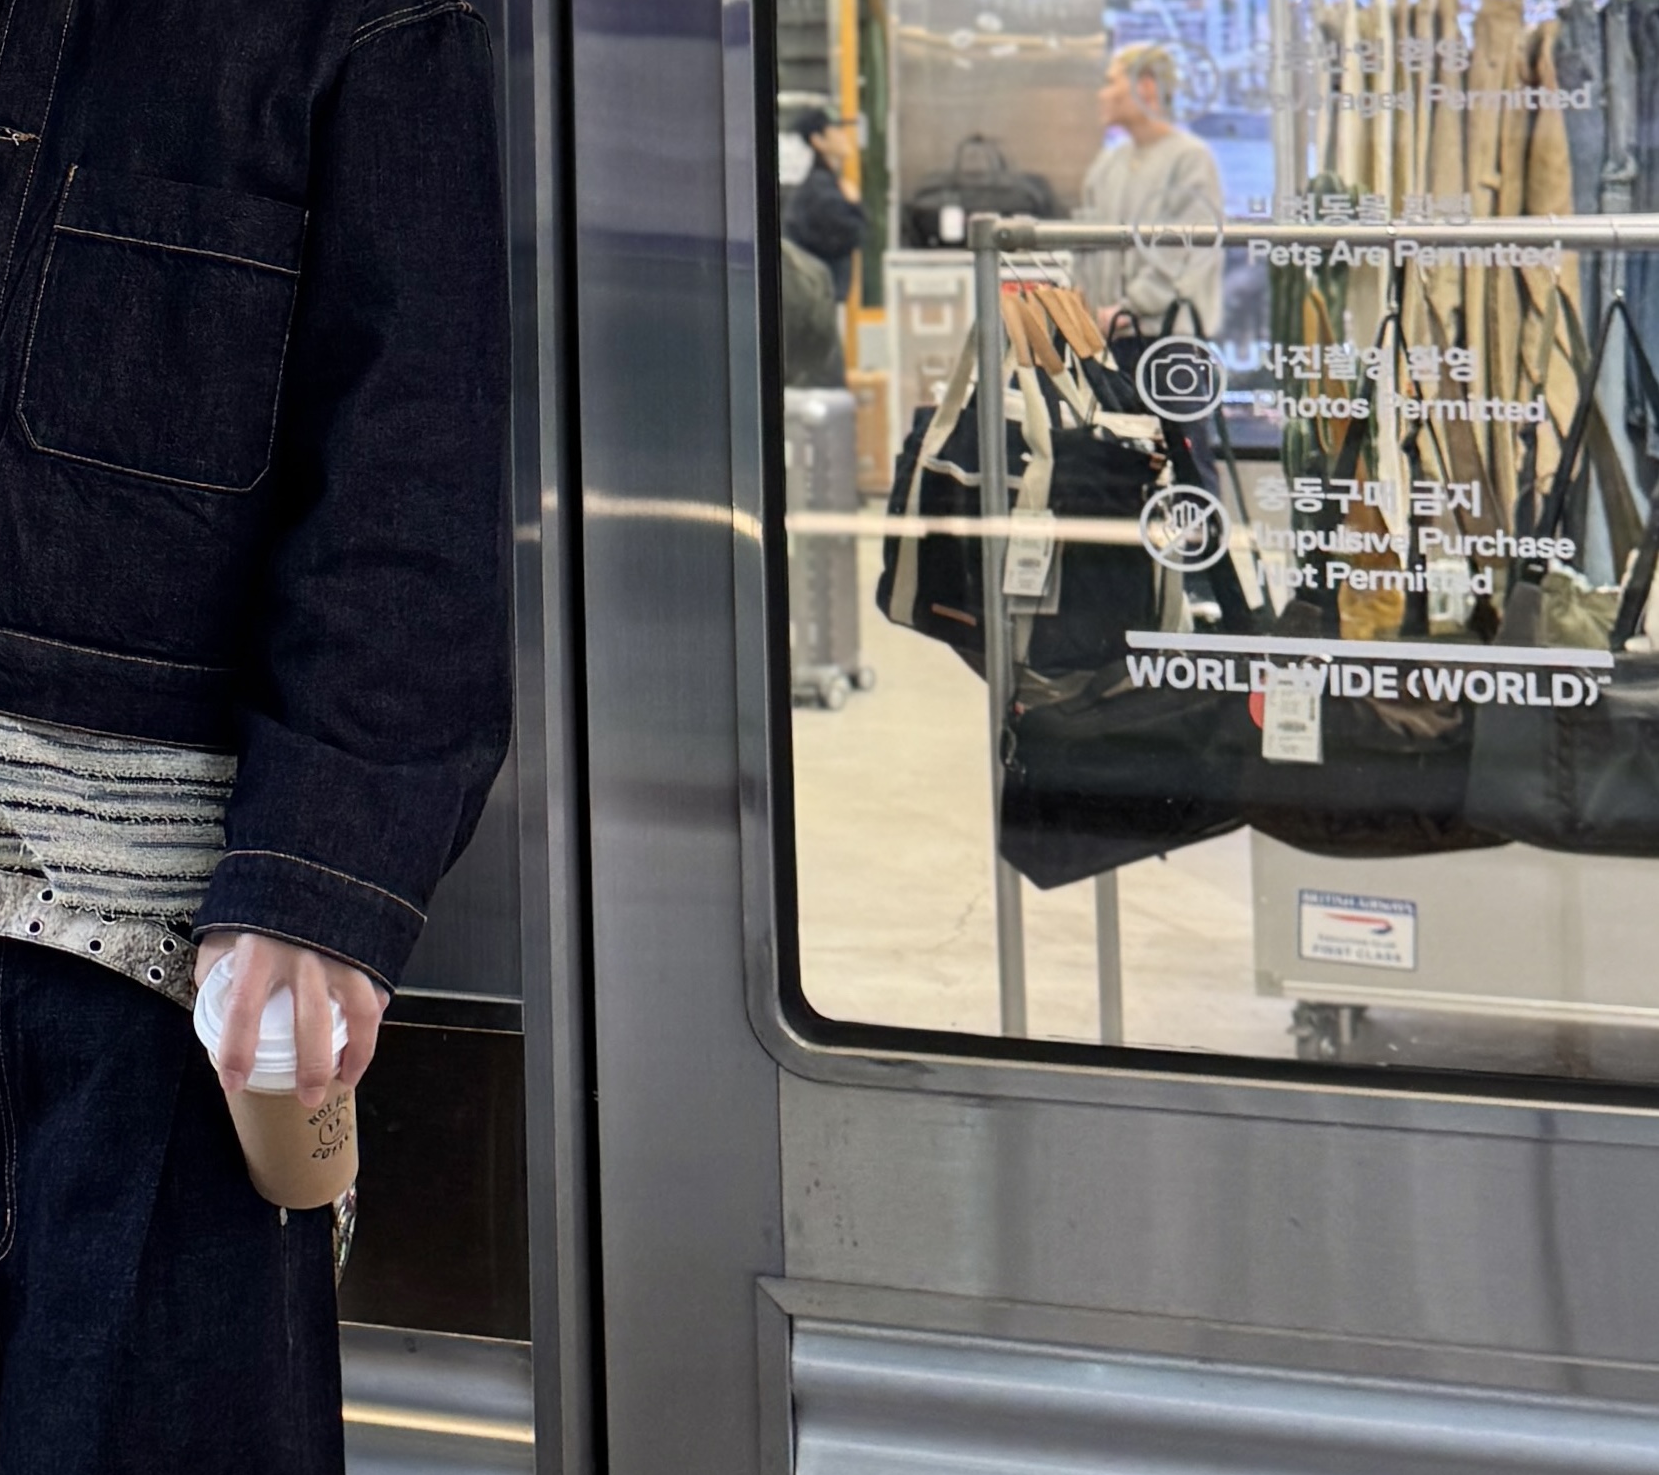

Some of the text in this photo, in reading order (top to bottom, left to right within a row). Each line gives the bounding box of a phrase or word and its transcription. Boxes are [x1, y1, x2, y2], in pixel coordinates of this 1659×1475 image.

[1424, 82, 1592, 112] Permitted
[1248, 239, 1562, 267] Pets Are Permitted
[1407, 345, 1478, 383] 환영
[1253, 389, 1370, 419] Photos
[1255, 477, 1482, 518] 충동구매 금지
[1256, 522, 1576, 560] Impulsive Purchase
[1257, 559, 1494, 595] Not Permitted
[1126, 654, 1280, 693] WORLD
